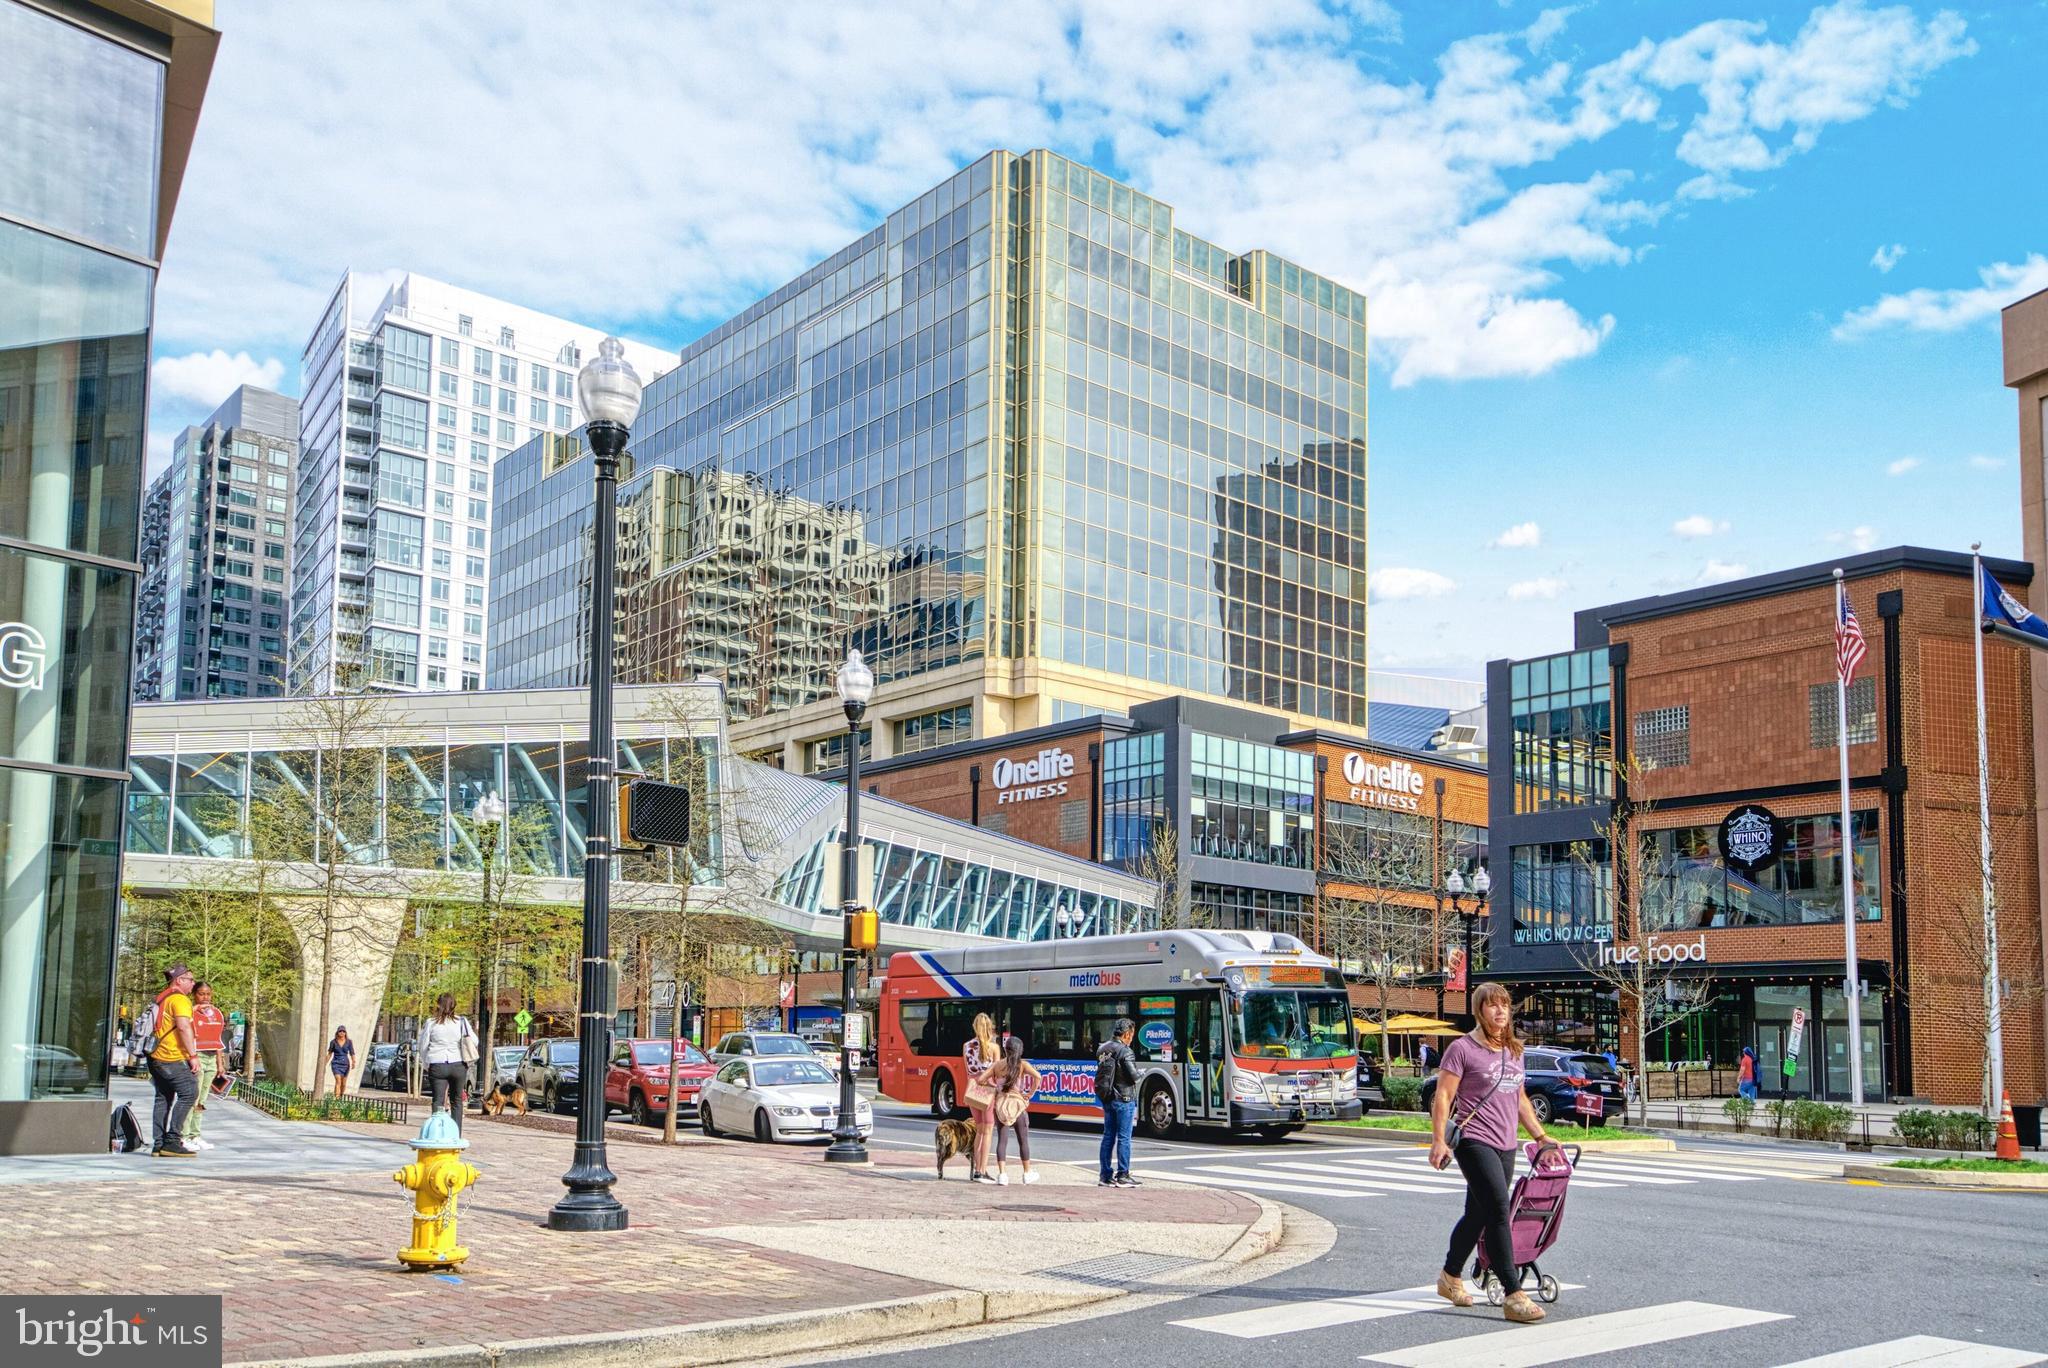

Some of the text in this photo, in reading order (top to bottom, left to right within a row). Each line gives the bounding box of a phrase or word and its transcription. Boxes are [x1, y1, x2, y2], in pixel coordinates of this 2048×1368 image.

[992, 747, 1074, 789] Onelife
[1343, 752, 1424, 795] Onelife
[998, 781, 1068, 804] FITNESS
[1350, 786, 1417, 810] FITNESS
[1733, 831, 1767, 844] WHINO
[1514, 927, 1552, 943] WHINO
[1555, 926, 1584, 941] NOW
[1594, 934, 1706, 967] True Food
[1069, 969, 1121, 987] metrobus
[661, 982, 690, 1008] 420
